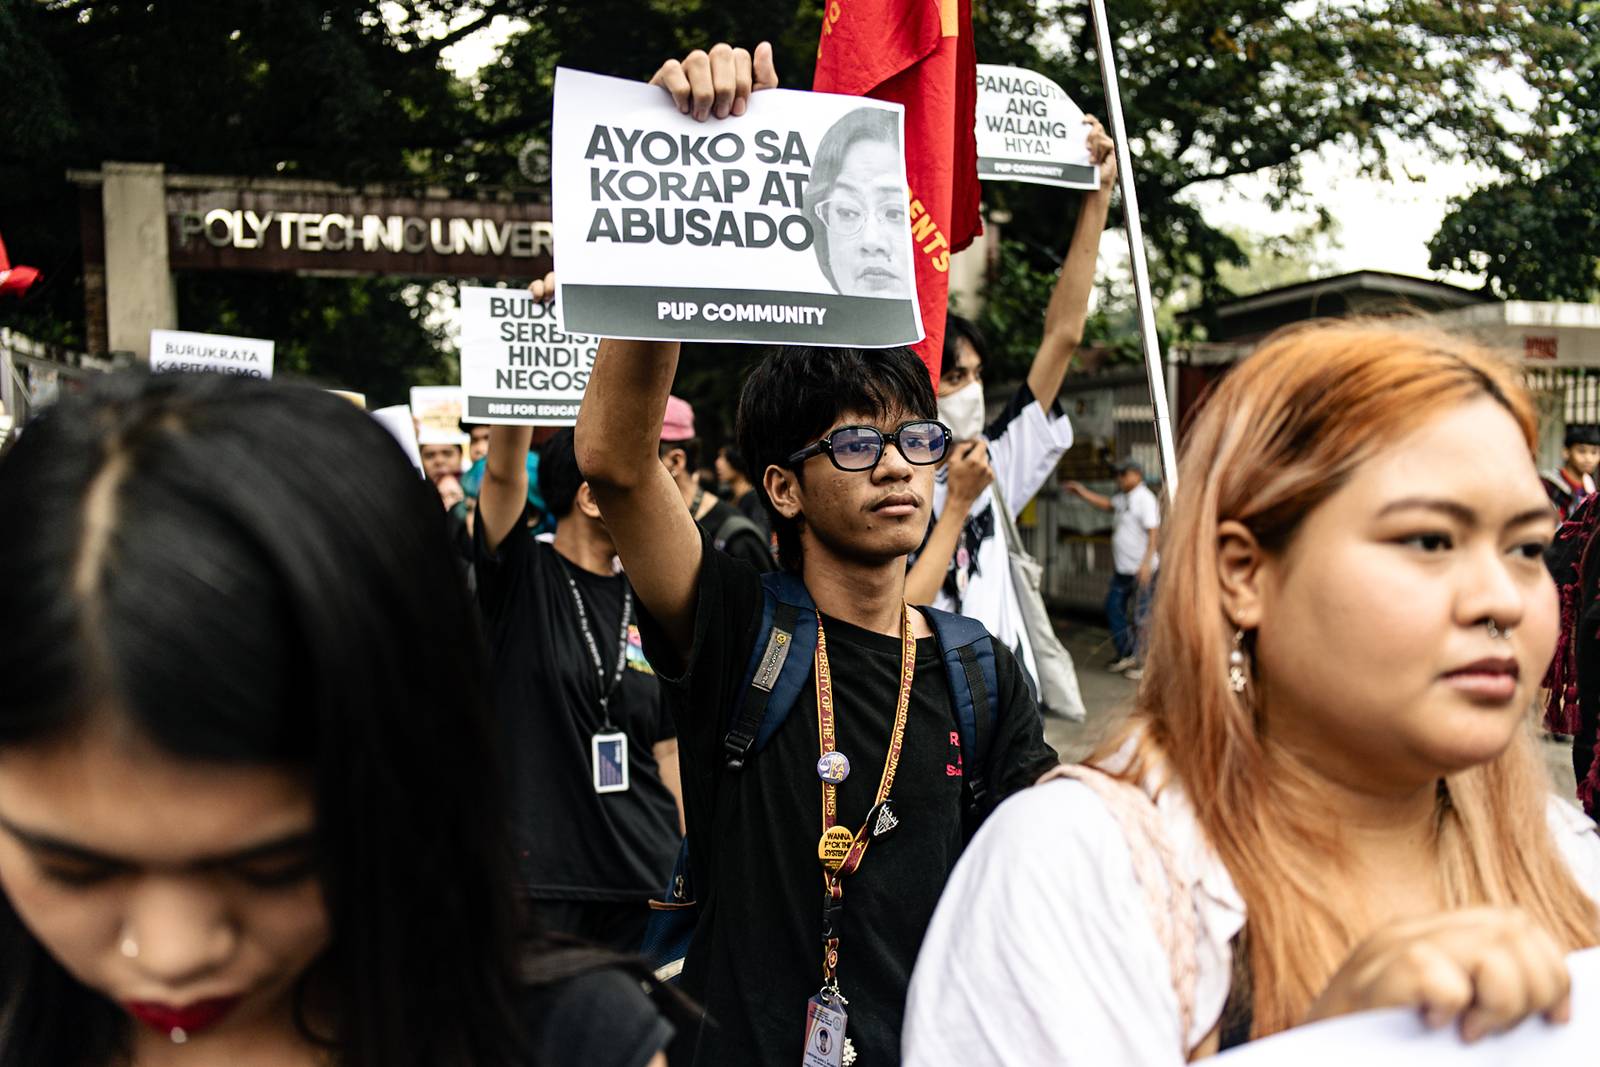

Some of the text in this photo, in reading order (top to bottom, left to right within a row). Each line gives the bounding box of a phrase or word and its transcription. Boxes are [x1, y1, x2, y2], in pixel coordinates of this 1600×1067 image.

[1006, 98, 1047, 117] ANG
[985, 115, 1067, 139] WALANG
[584, 124, 811, 167] AYOKO SA
[1004, 137, 1051, 155] HIYA!
[591, 167, 809, 209] KORAP AT
[176, 208, 428, 254] POLYTECHNIC
[586, 208, 814, 251] ABUSADO
[657, 301, 827, 325] PUP COMMUNITY
[165, 343, 259, 362] BURUKRATA
[508, 345, 579, 368] HINDI
[496, 368, 591, 391] NEGOS
[488, 403, 512, 416] RISE
[513, 404, 536, 416] FOR
[821, 696, 831, 714] OF
[894, 682, 911, 750] UNIVERSITY
[822, 715, 834, 740] THE
[826, 832, 851, 841] WANNA
